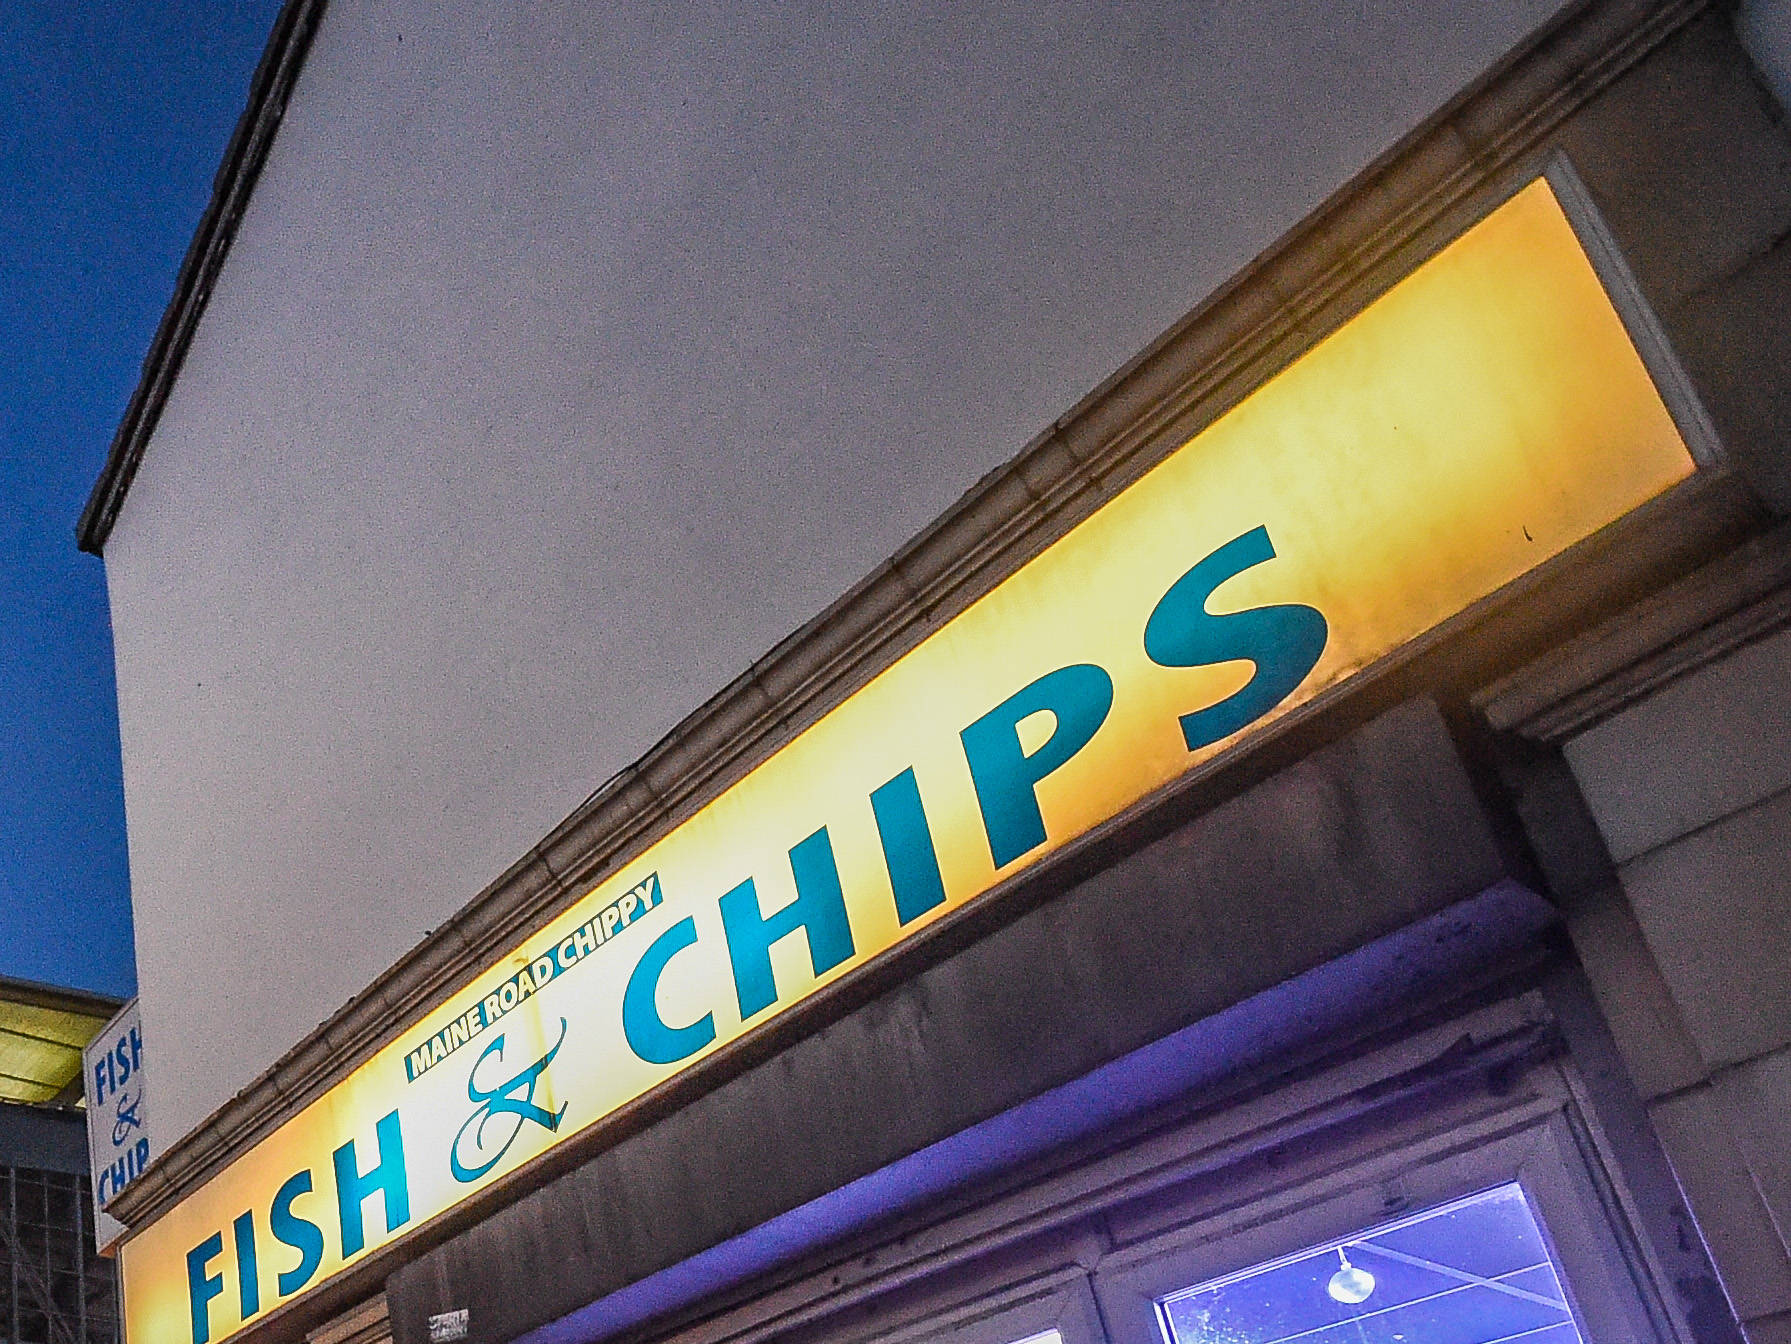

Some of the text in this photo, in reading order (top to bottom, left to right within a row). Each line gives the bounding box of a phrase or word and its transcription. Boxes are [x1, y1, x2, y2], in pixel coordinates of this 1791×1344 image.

[450, 1016, 569, 1184] &
[622, 524, 1329, 1066] CHIPS
[409, 875, 657, 1078] MAINE ROAD CHIPPY
[98, 1136, 150, 1205] CHIP
